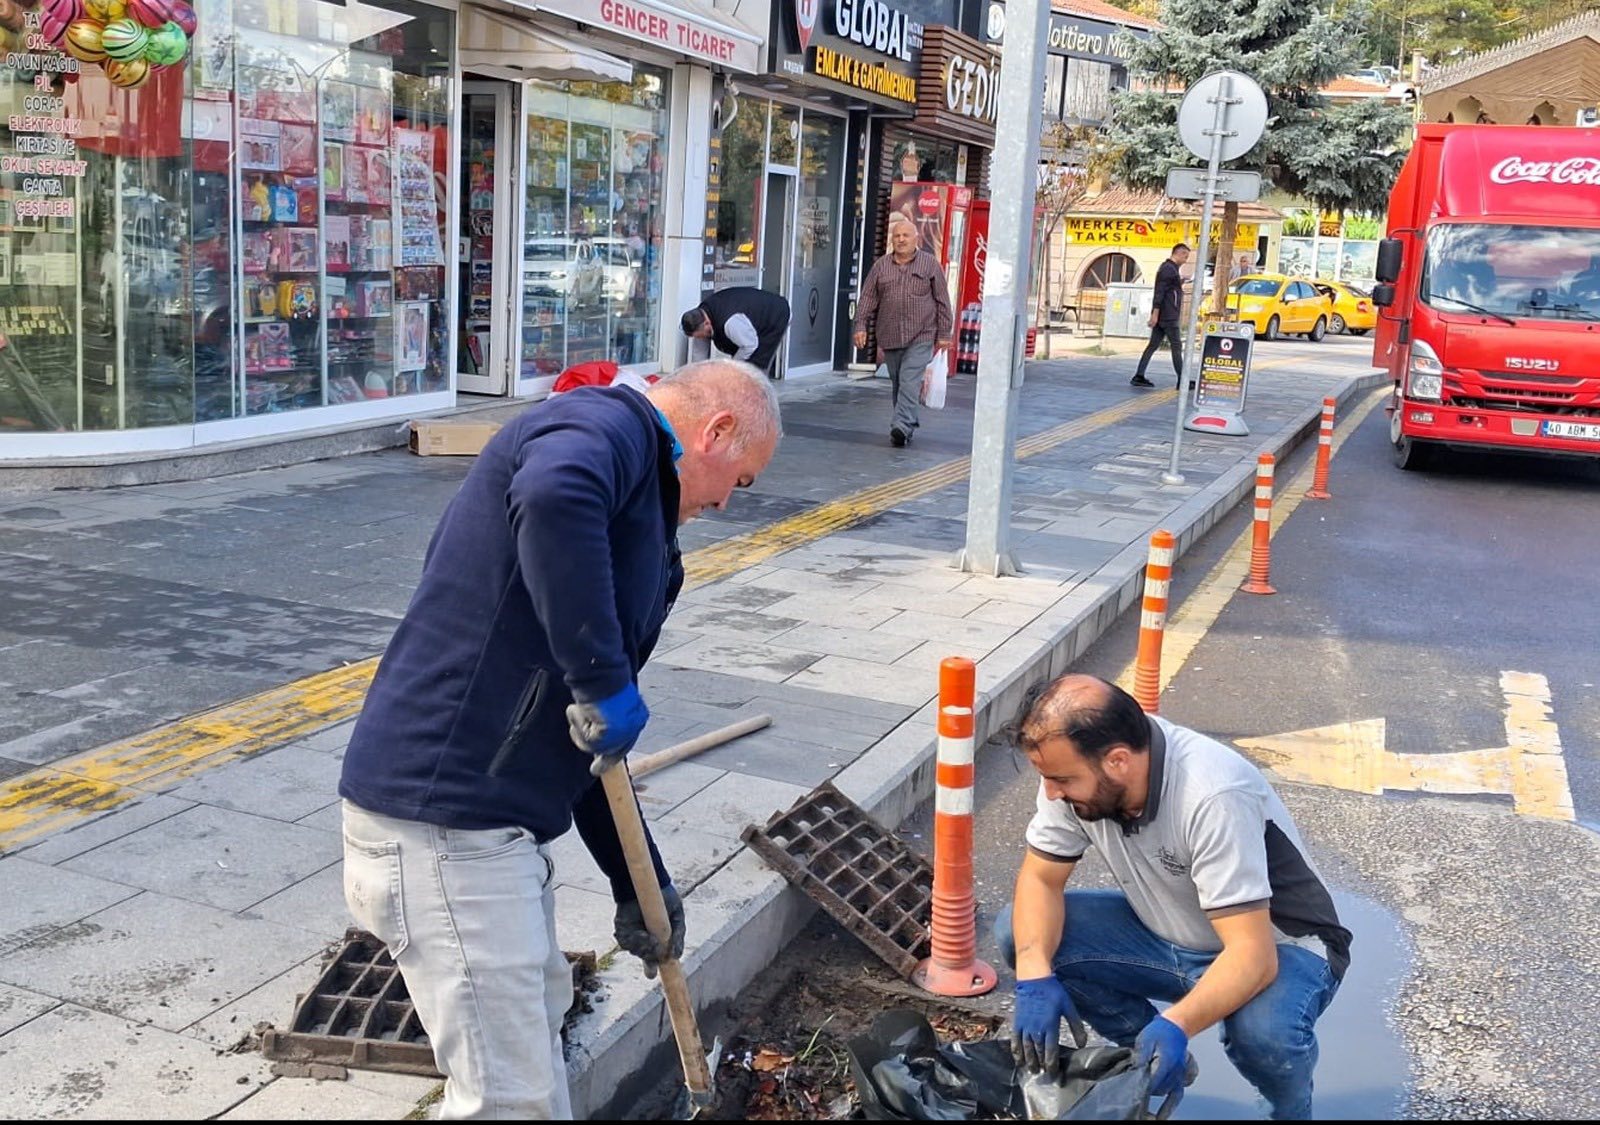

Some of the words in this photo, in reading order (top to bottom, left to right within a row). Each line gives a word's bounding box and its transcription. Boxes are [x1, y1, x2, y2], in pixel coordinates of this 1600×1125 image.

[600, 0, 669, 41] GENCER
[836, 0, 912, 62] GLOBAL
[815, 45, 851, 83] EMLAK
[852, 59, 860, 87] &
[946, 54, 1000, 123] GEDİ
[1069, 219, 1135, 231] MERKEZ
[1204, 357, 1244, 367] GLOBAL
[1504, 357, 1560, 371] ISUZU
